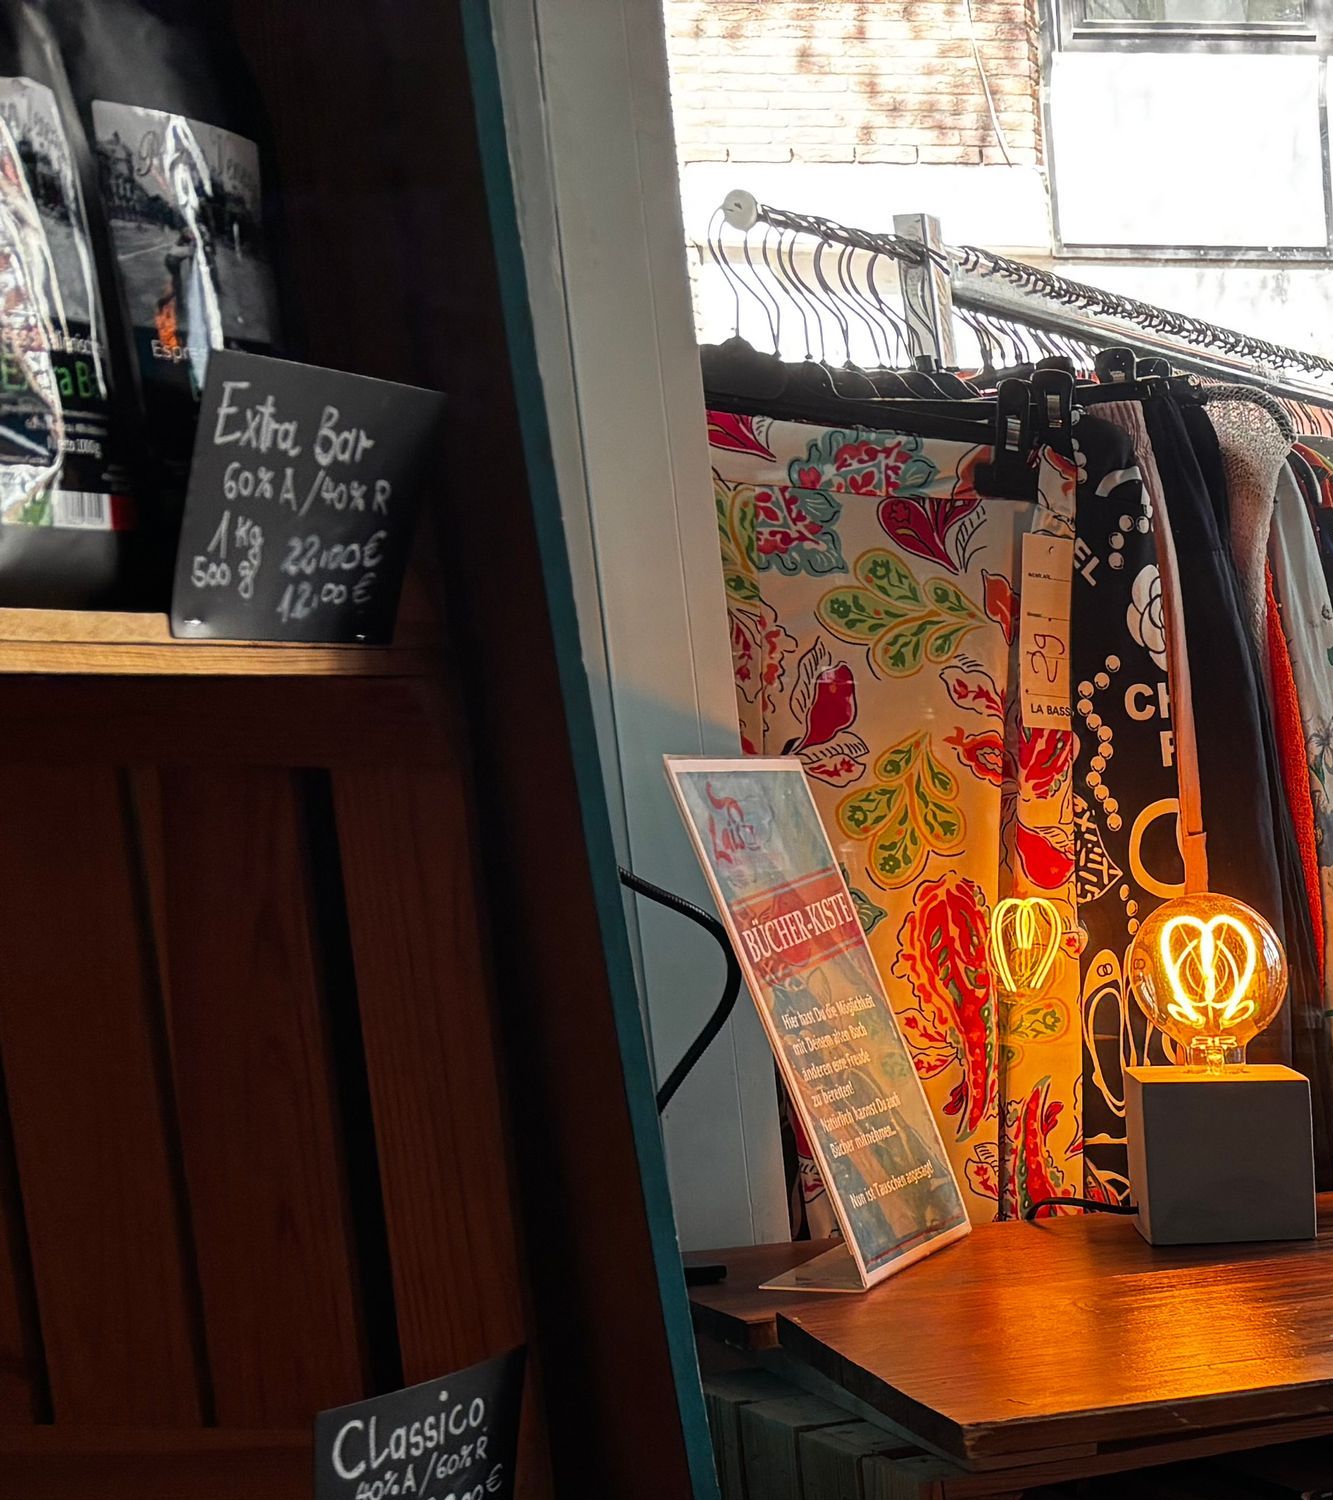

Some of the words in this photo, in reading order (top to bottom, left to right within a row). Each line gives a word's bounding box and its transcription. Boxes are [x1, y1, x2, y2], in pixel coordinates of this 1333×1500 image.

[213, 381, 302, 457] Extra
[314, 405, 375, 467] Bar
[1030, 703, 1044, 715] LA
[742, 891, 854, 964] BÜCHER-KISTE
[782, 1013, 799, 1030] Hier
[837, 994, 876, 1017] Möglichkeit
[792, 1040, 807, 1056] mit
[807, 1033, 833, 1052] Deinem
[801, 1061, 833, 1082] anderen
[850, 1048, 871, 1068] Freude
[811, 1093, 822, 1108] zu
[850, 1192, 866, 1209] Nun
[874, 1175, 906, 1198] Tauschen
